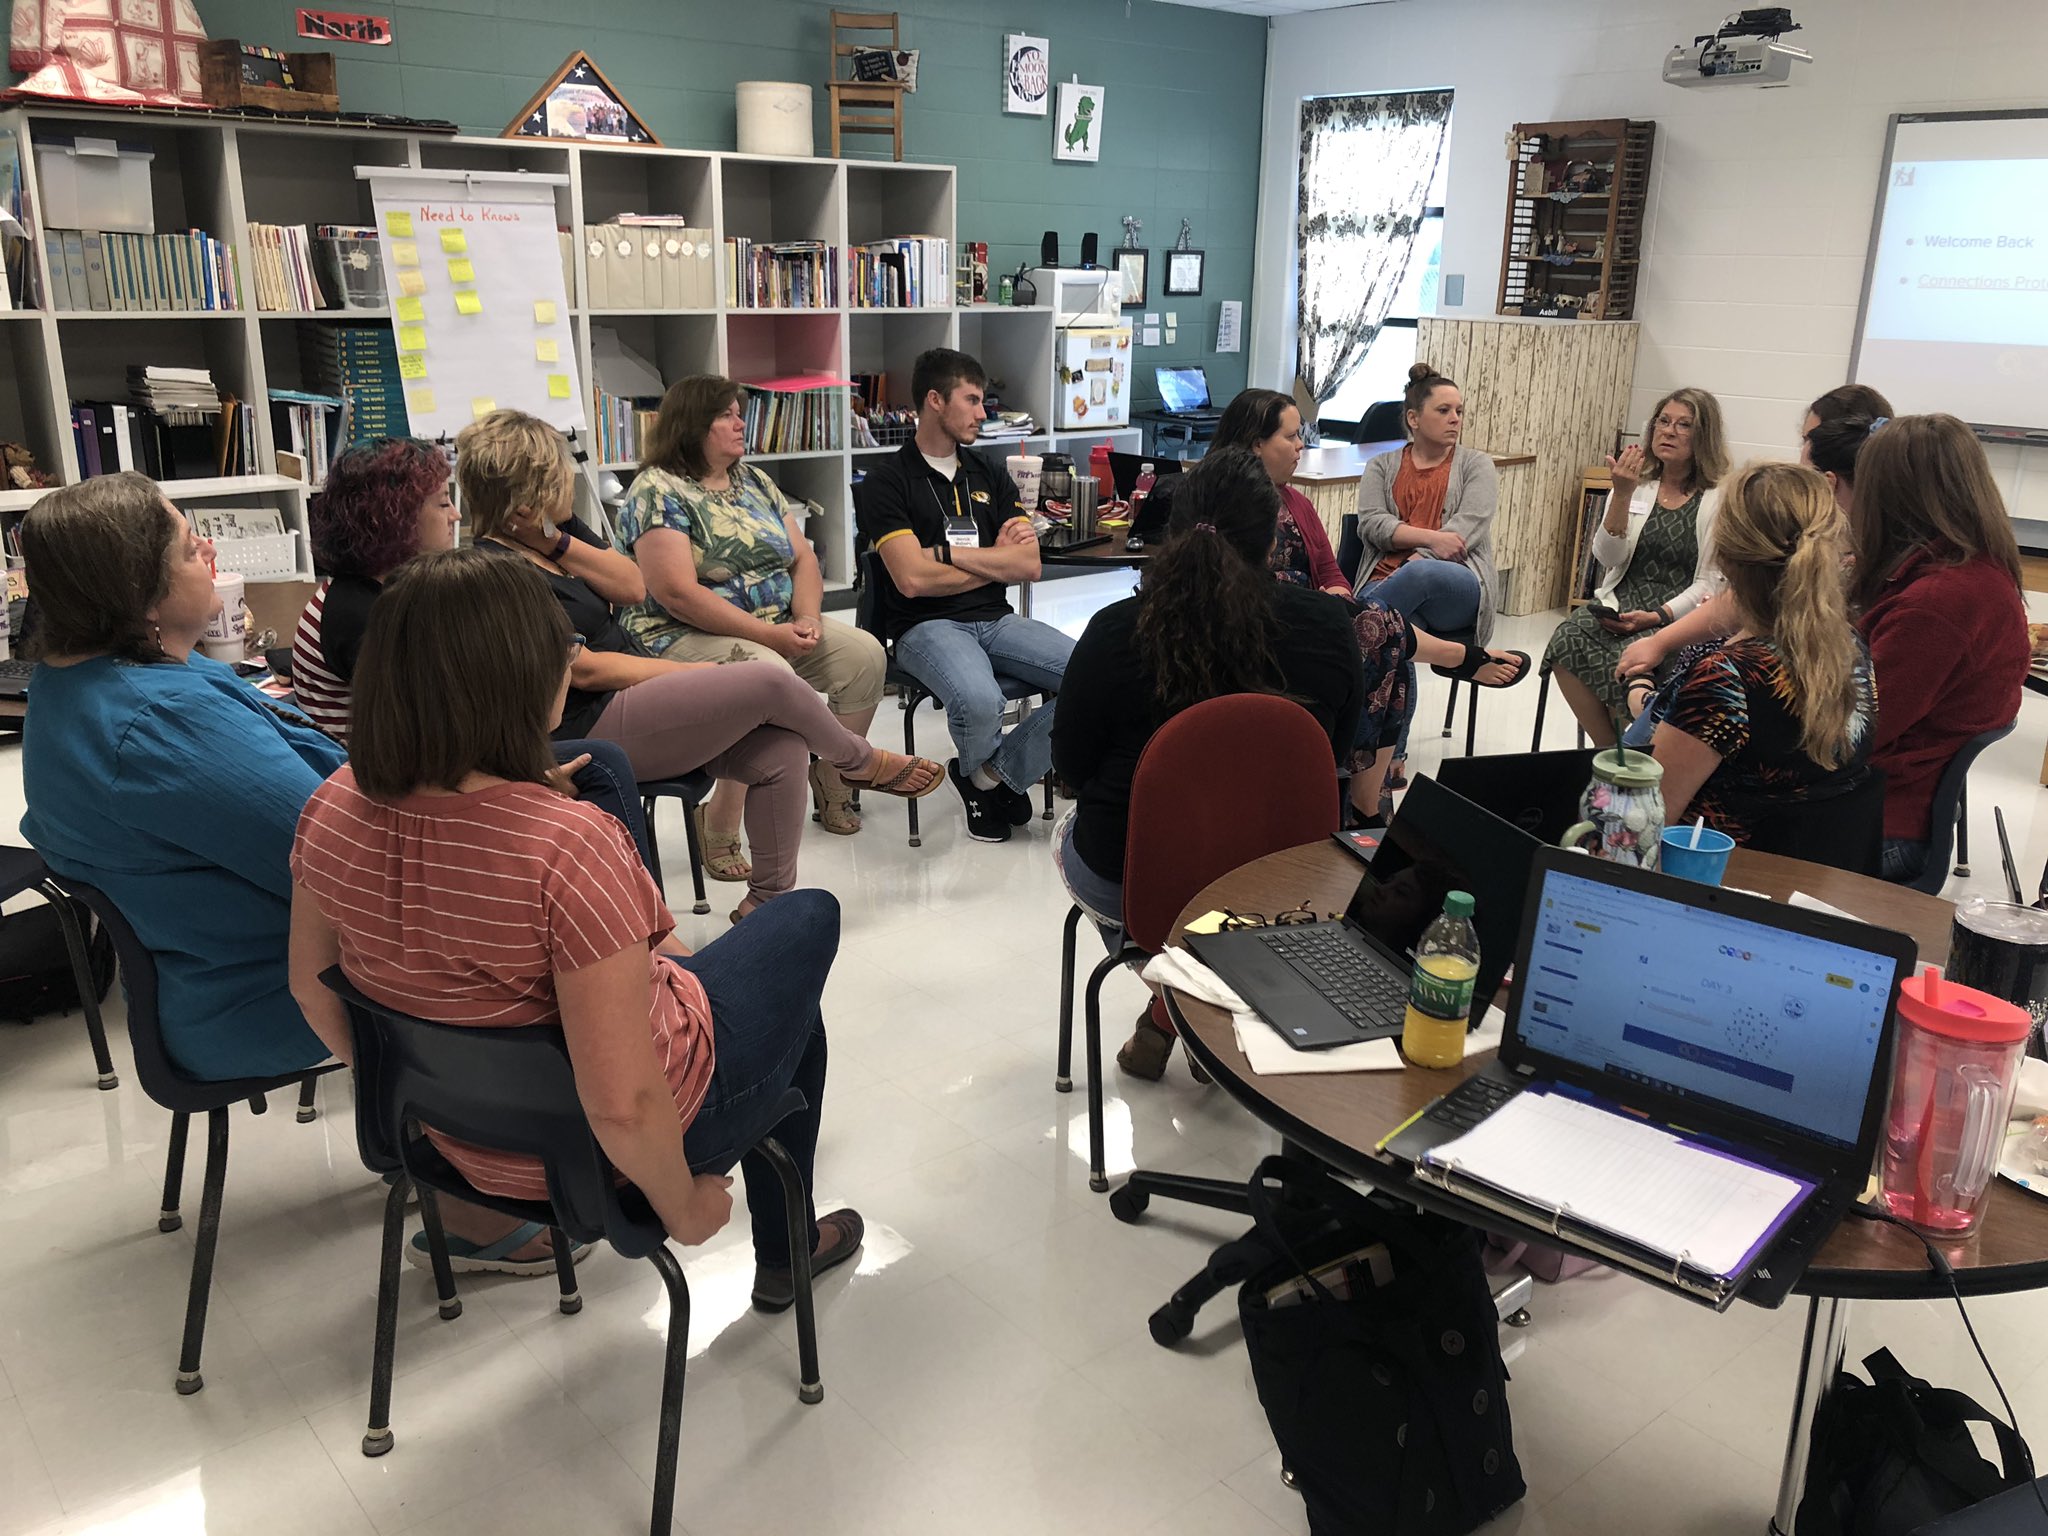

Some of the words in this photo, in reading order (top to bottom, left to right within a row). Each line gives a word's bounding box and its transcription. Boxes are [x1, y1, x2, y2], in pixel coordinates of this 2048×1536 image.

[304, 14, 383, 40] North
[1026, 50, 1041, 62] TO
[1019, 63, 1047, 76] MOON
[1024, 74, 1049, 95] BACK
[420, 204, 455, 222] Need
[460, 207, 474, 221] to
[481, 207, 520, 221] Knows
[1924, 235, 1992, 249] Welcome
[1996, 235, 2035, 249] Back
[1918, 274, 2011, 289] Connections
[2014, 275, 2048, 289] Prot
[1539, 308, 1559, 316] Asbill
